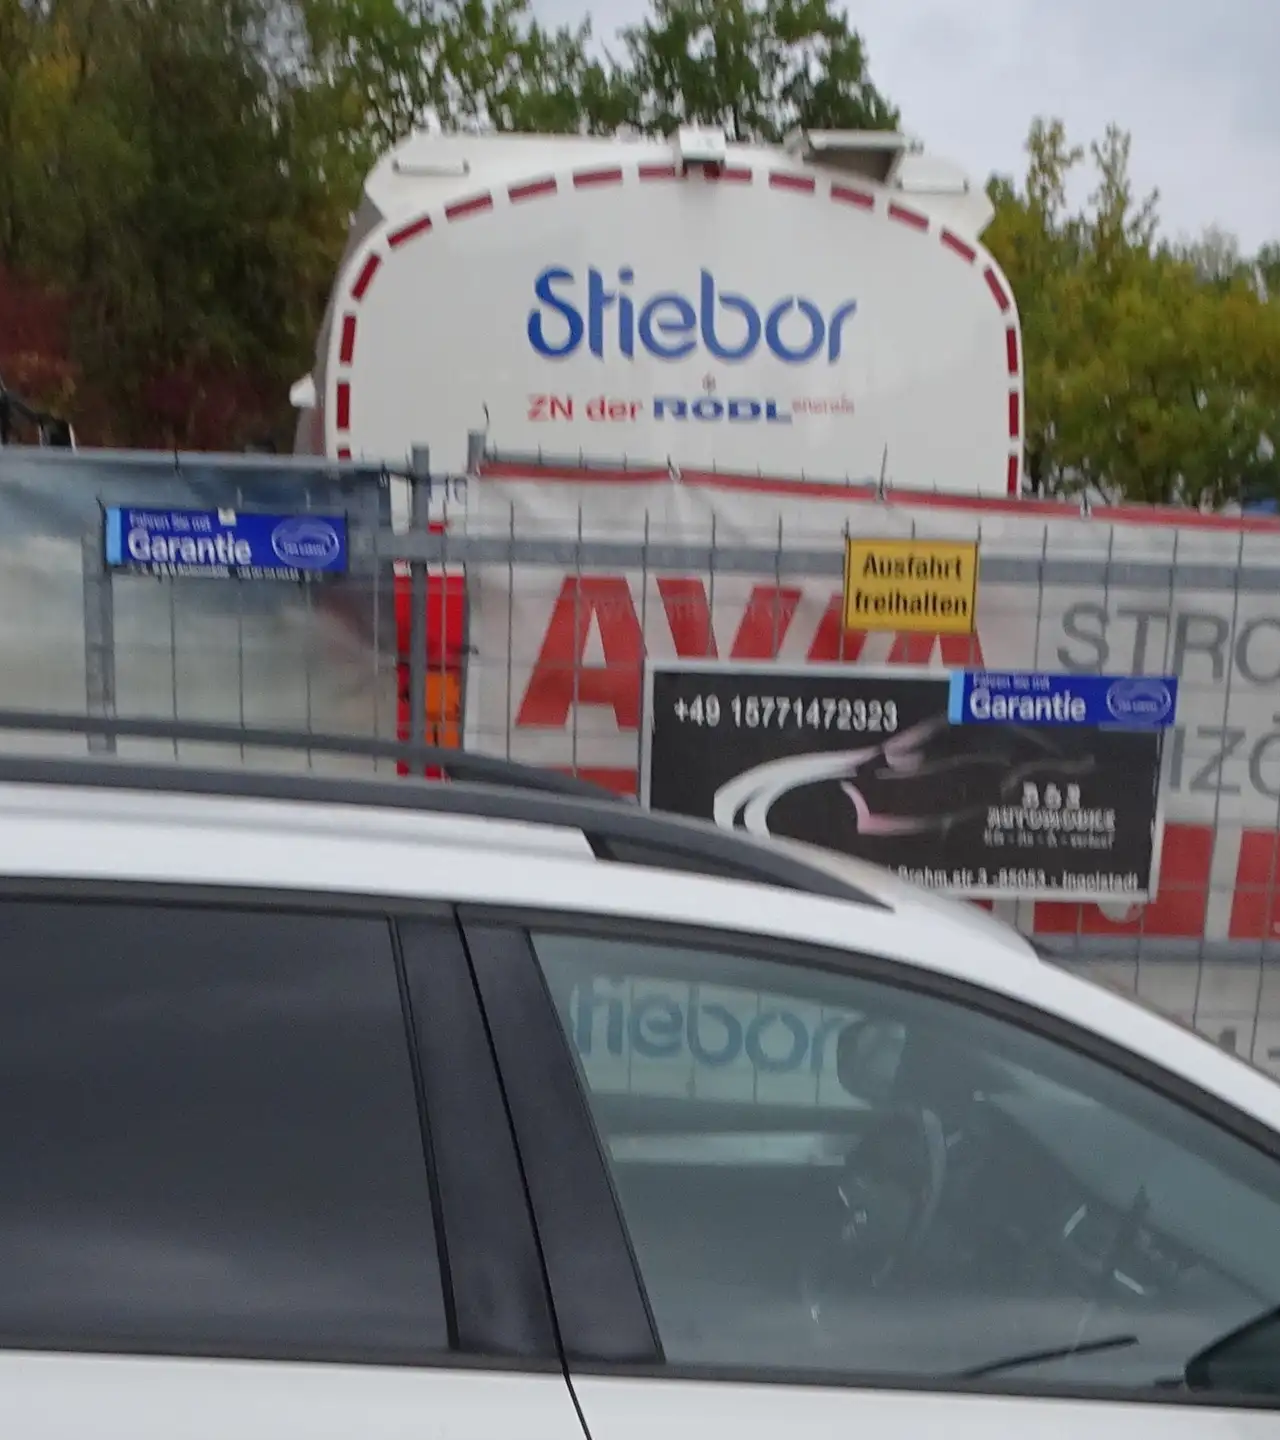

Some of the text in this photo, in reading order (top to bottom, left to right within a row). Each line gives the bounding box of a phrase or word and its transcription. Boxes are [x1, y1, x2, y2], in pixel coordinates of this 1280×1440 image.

[527, 265, 858, 364] Stiebor
[586, 393, 643, 422] der
[128, 527, 252, 566] Garantie
[861, 552, 963, 583] Ausfahrt
[853, 586, 969, 619] freihalten
[970, 687, 1087, 722] Garantie
